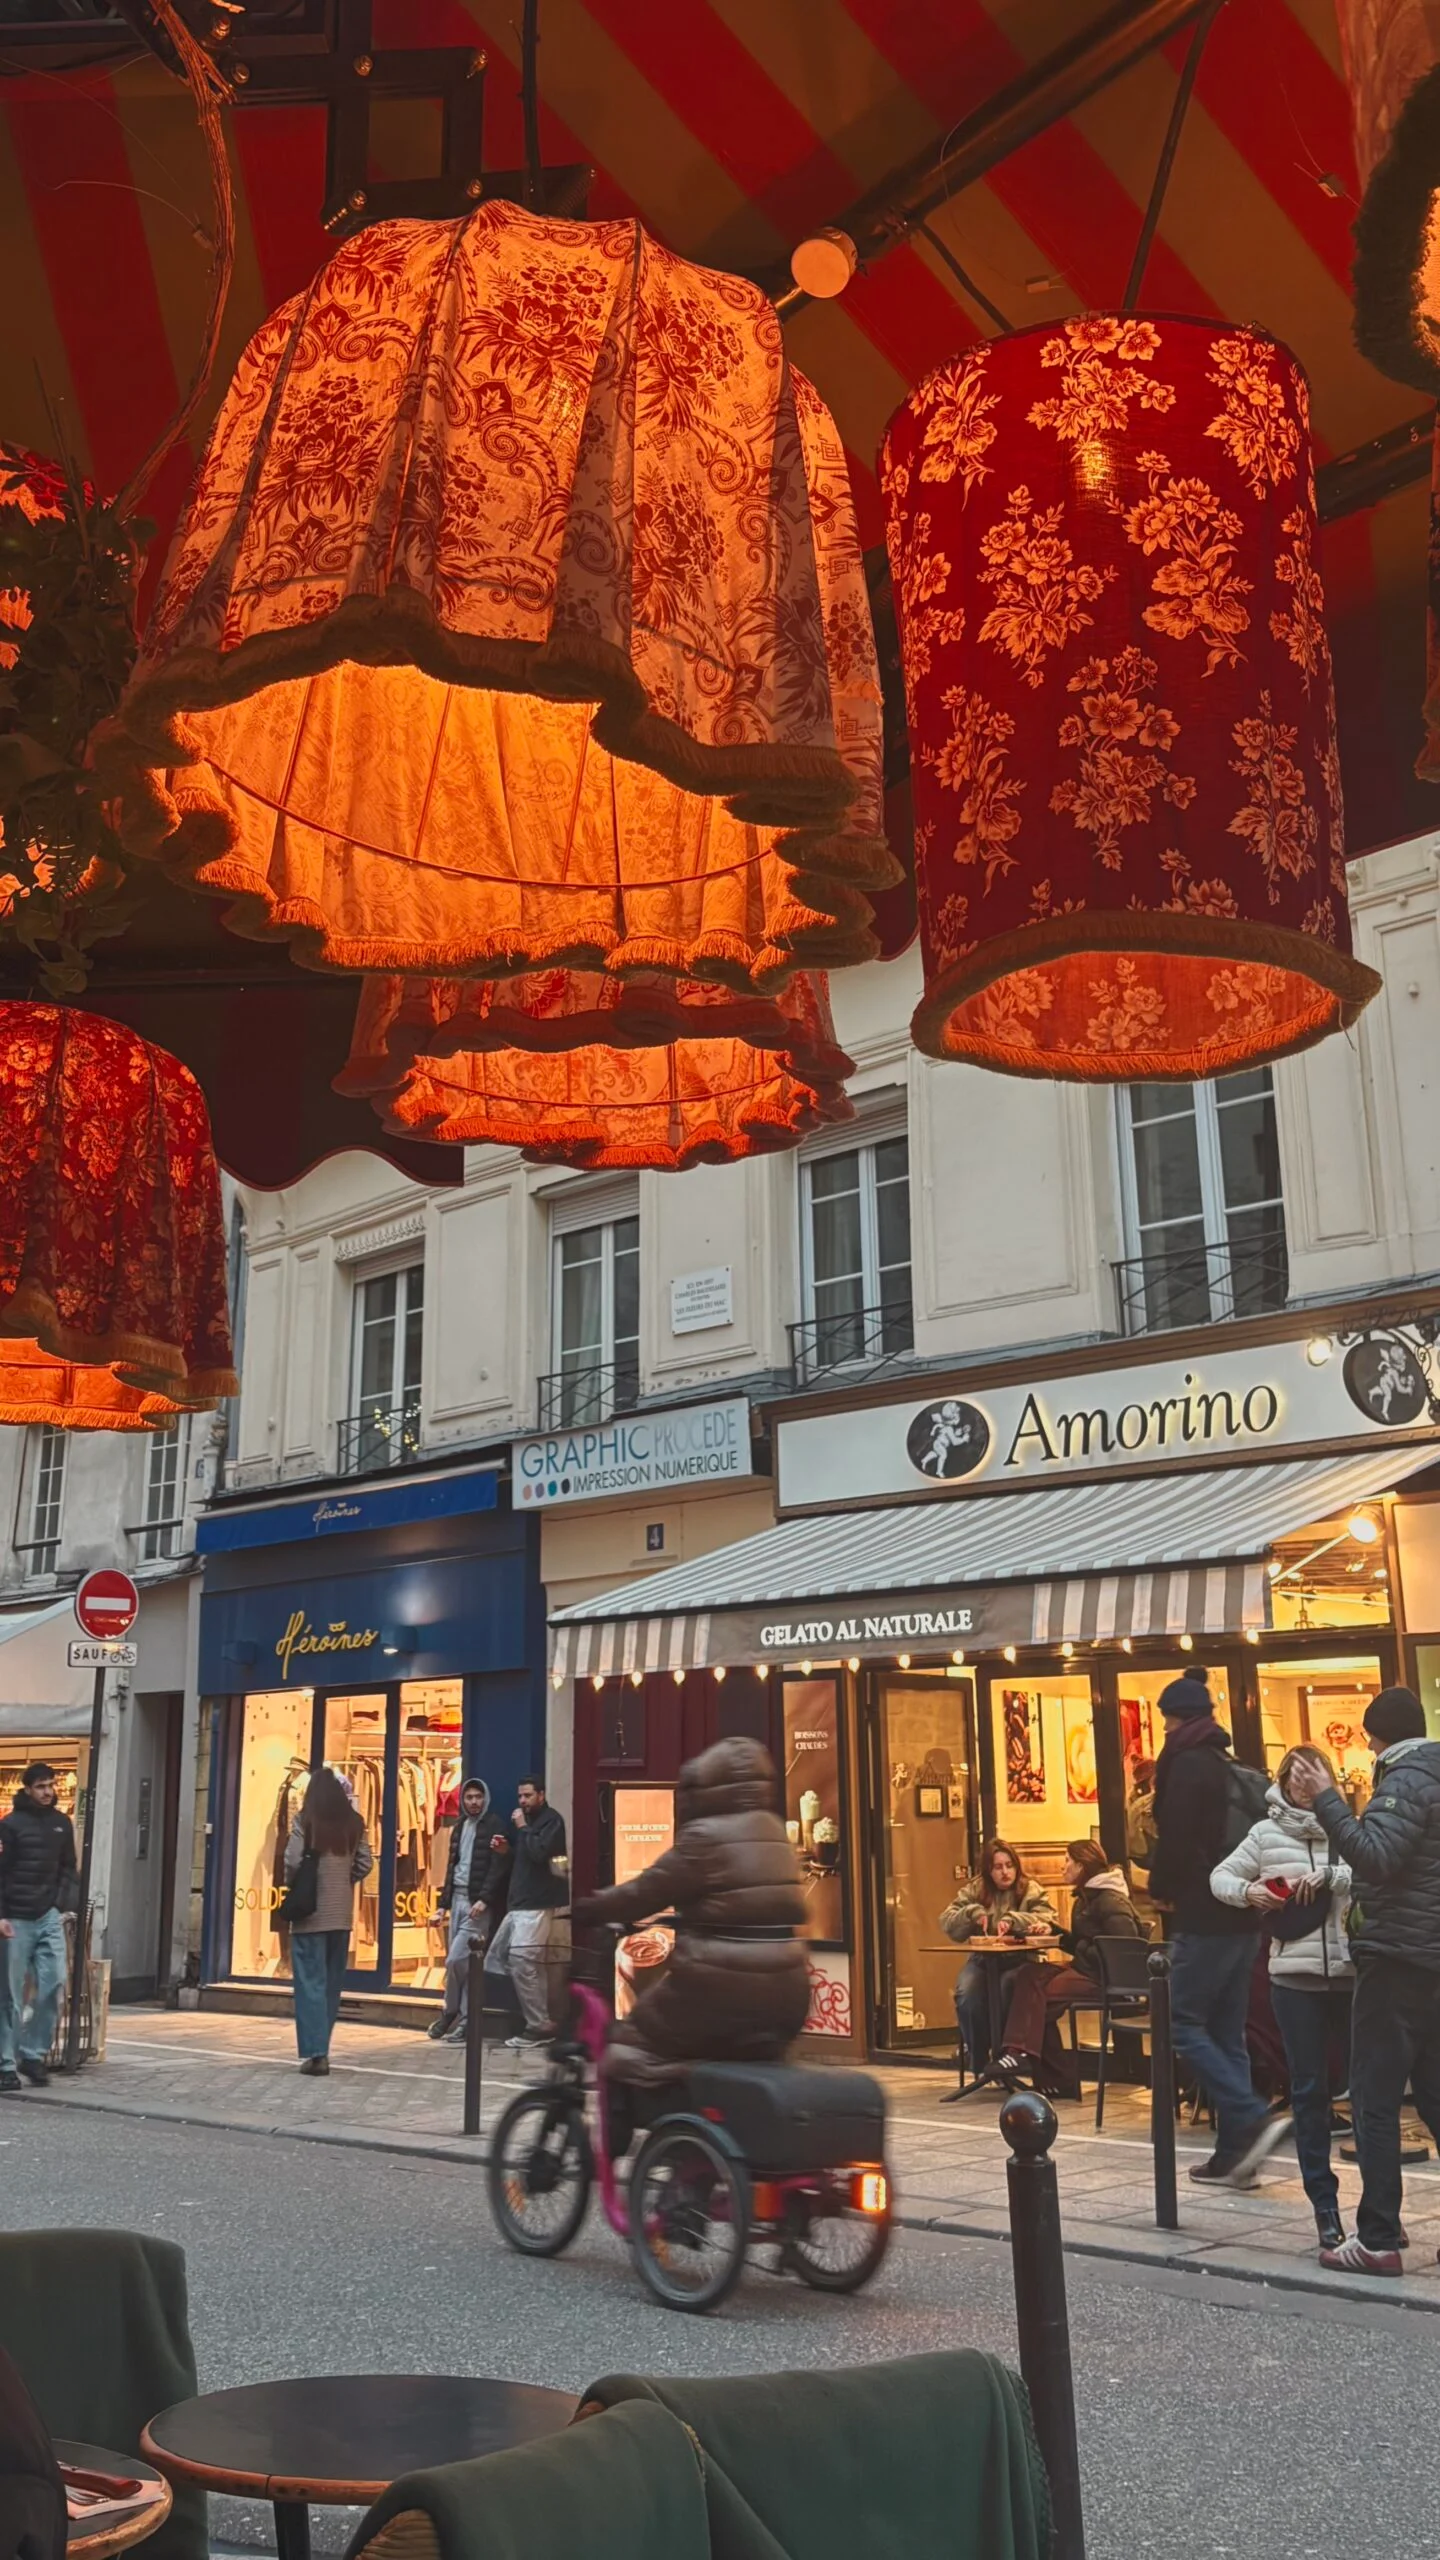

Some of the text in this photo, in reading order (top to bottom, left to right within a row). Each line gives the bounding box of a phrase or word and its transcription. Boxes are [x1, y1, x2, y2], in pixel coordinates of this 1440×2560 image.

[1003, 1374, 1278, 1466] Amorino
[520, 1408, 737, 1478] GRAPHIC PROCEDE
[573, 1450, 738, 1494] IMPRESSION NUMERIQUE
[760, 1609, 973, 1646] GELATO AL NATURALE
[73, 1648, 108, 1660] SAUF
